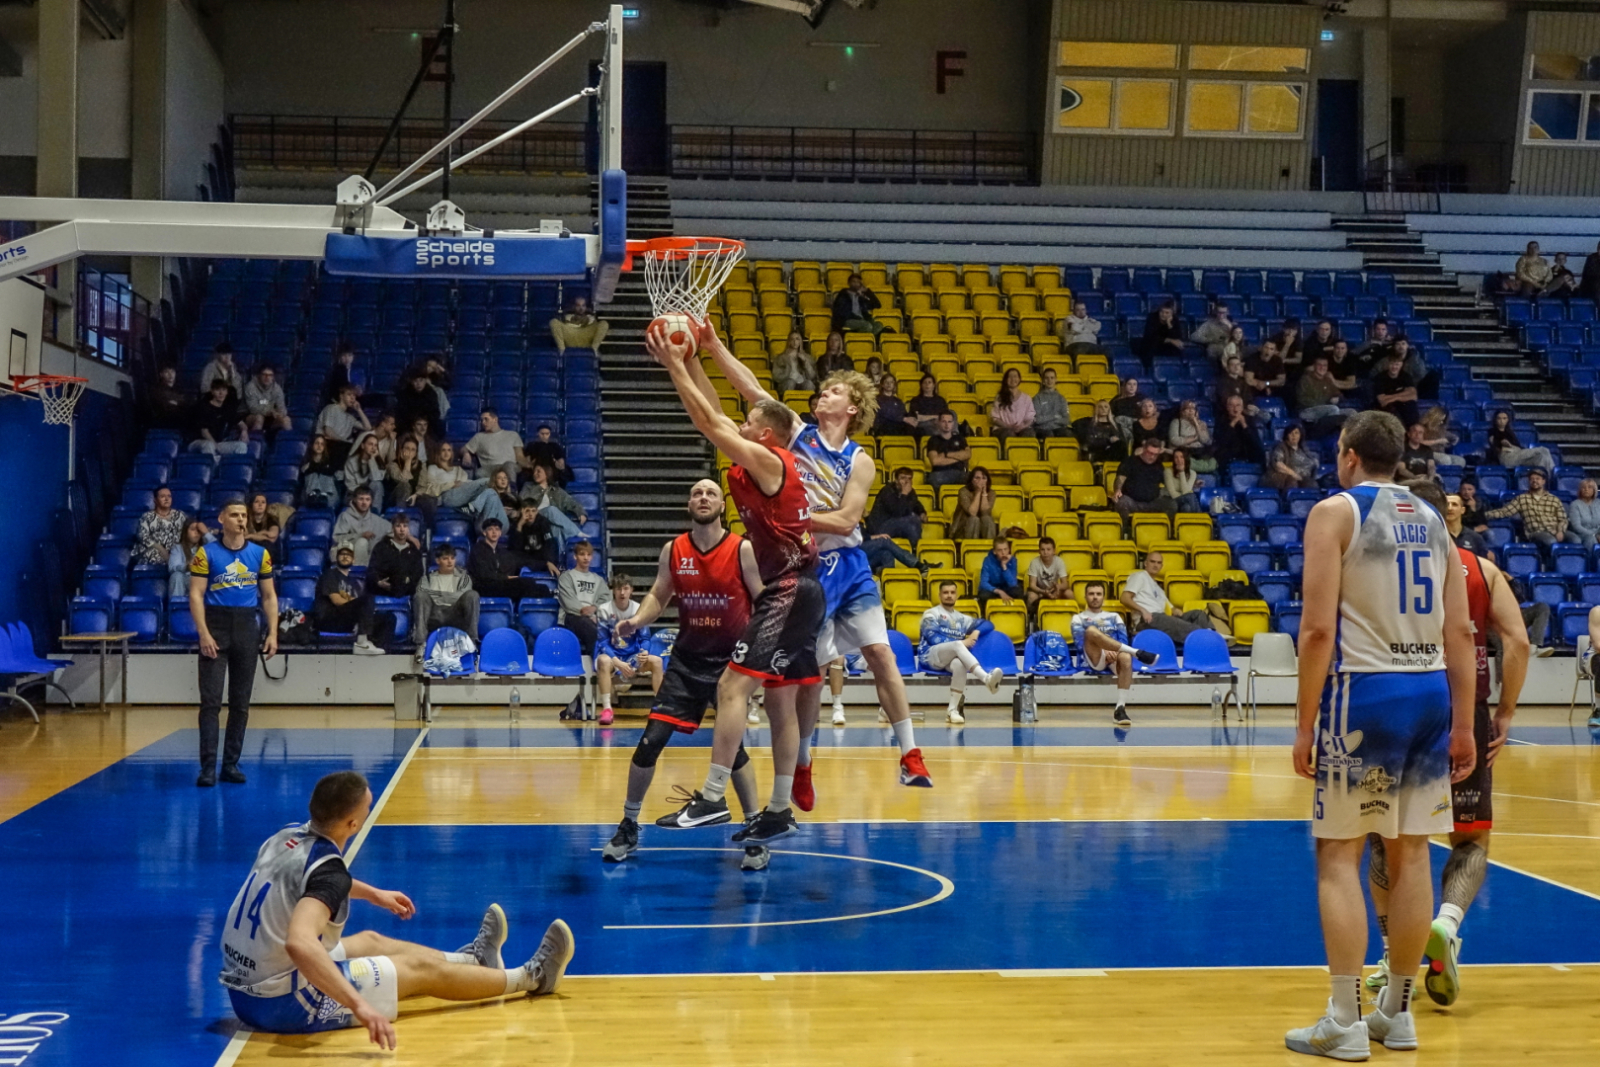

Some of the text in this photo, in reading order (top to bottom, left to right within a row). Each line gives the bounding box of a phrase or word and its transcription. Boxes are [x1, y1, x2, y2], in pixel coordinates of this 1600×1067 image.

[936, 50, 967, 94] F
[416, 239, 495, 253] Schelde
[416, 252, 495, 268] Sports
[1393, 521, 1427, 544] LĀCIS
[680, 557, 694, 569] 21
[1396, 549, 1433, 615] 15
[1390, 643, 1438, 655] BUCHER
[1360, 799, 1390, 811] BUCHER
[233, 871, 272, 940] 14
[224, 943, 257, 971] BUCHER
